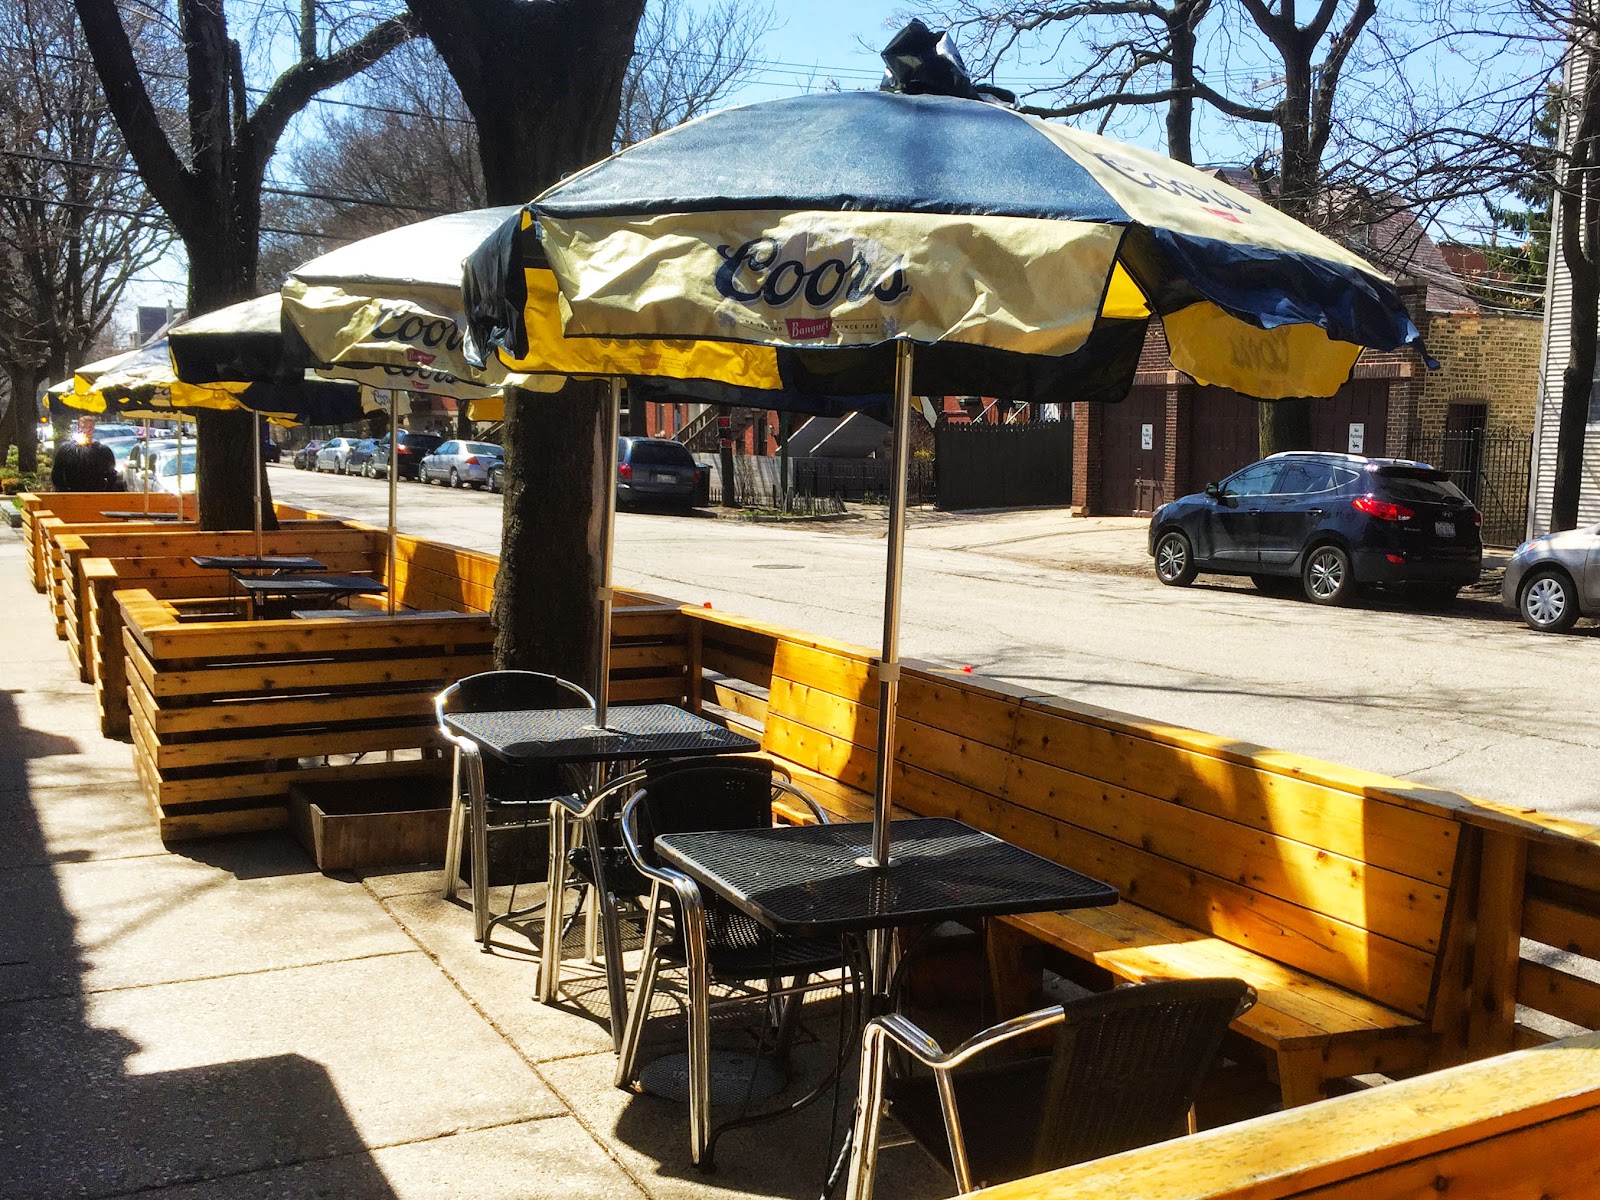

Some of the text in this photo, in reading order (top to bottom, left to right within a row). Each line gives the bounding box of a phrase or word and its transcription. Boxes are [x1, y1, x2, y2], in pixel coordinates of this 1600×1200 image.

[1093, 152, 1252, 214] Coors
[715, 235, 910, 308] Coors
[371, 309, 463, 351] Coor
[792, 318, 829, 338] Banquet
